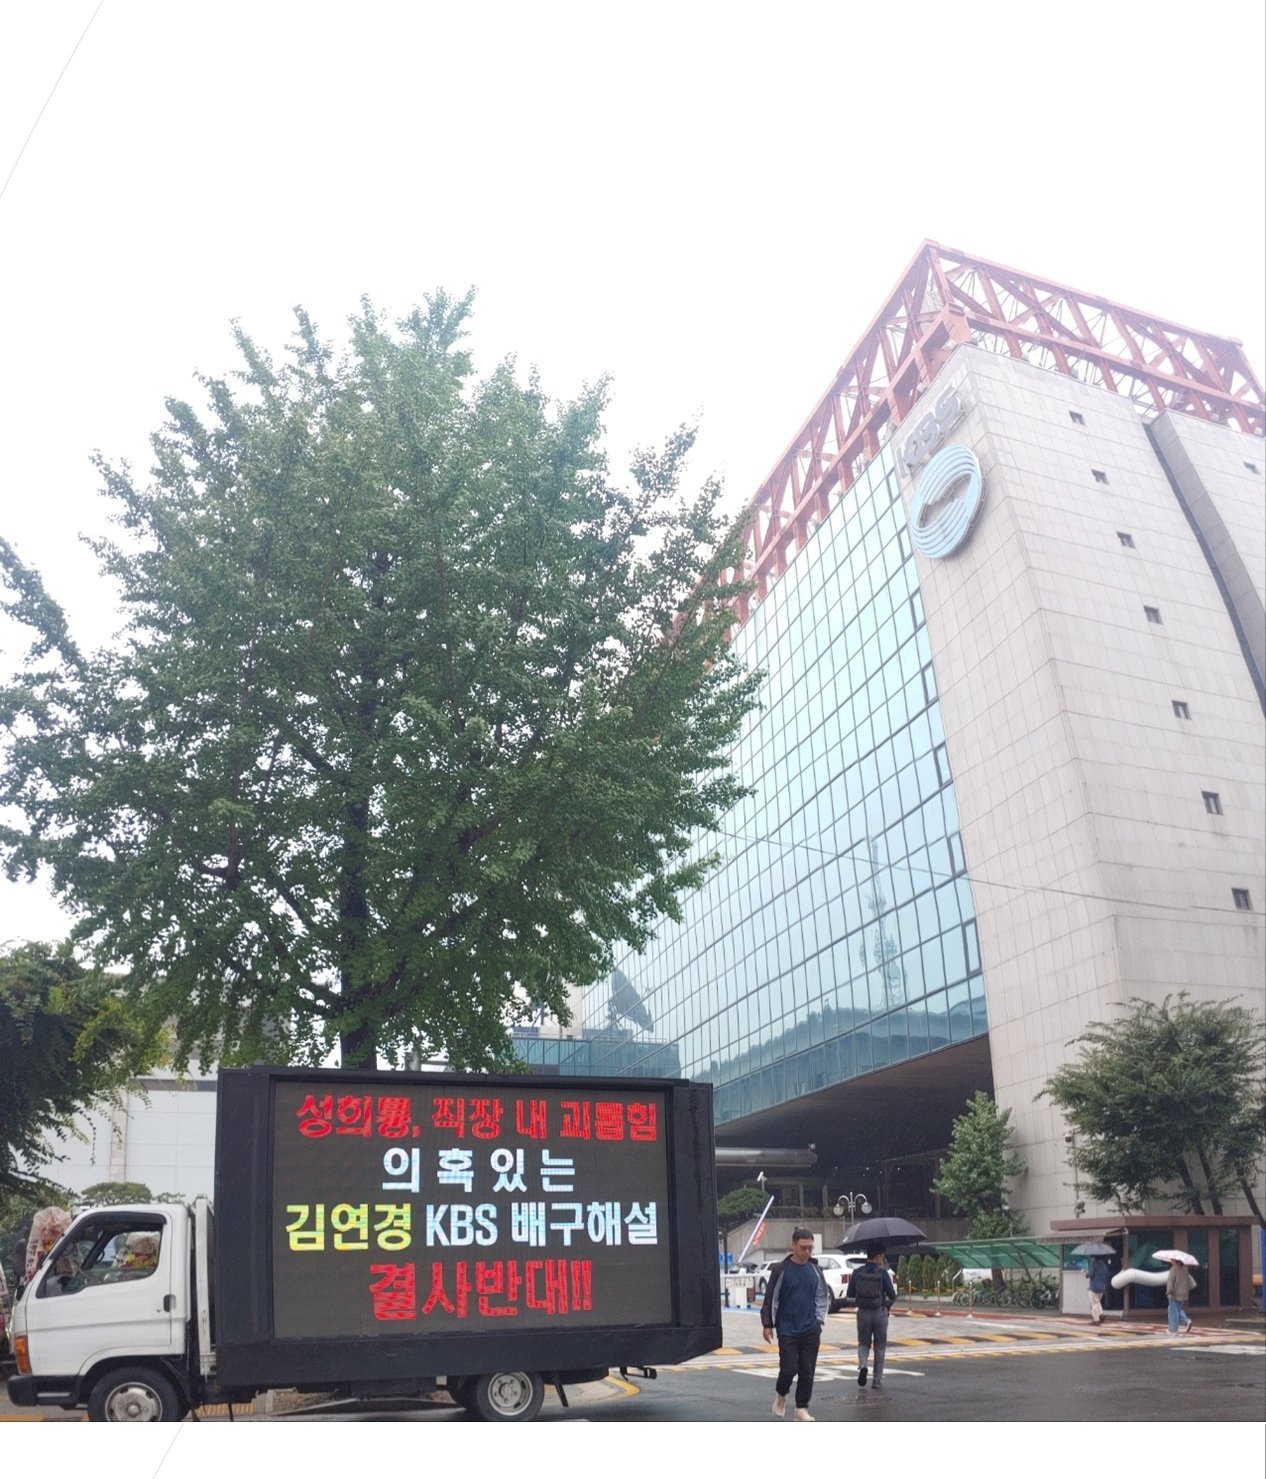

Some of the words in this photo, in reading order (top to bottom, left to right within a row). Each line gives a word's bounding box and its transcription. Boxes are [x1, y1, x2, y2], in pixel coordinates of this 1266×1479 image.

[897, 384, 966, 478] KBS
[295, 1093, 421, 1140] 성희롱,
[432, 1097, 504, 1140] 직장
[516, 1098, 547, 1140] 내
[560, 1100, 658, 1142] 괴롭힘
[286, 1202, 411, 1251] 김연경
[426, 1203, 498, 1246] KBS
[511, 1201, 658, 1247] 배구해설
[368, 1258, 593, 1321] 결사반대!!
